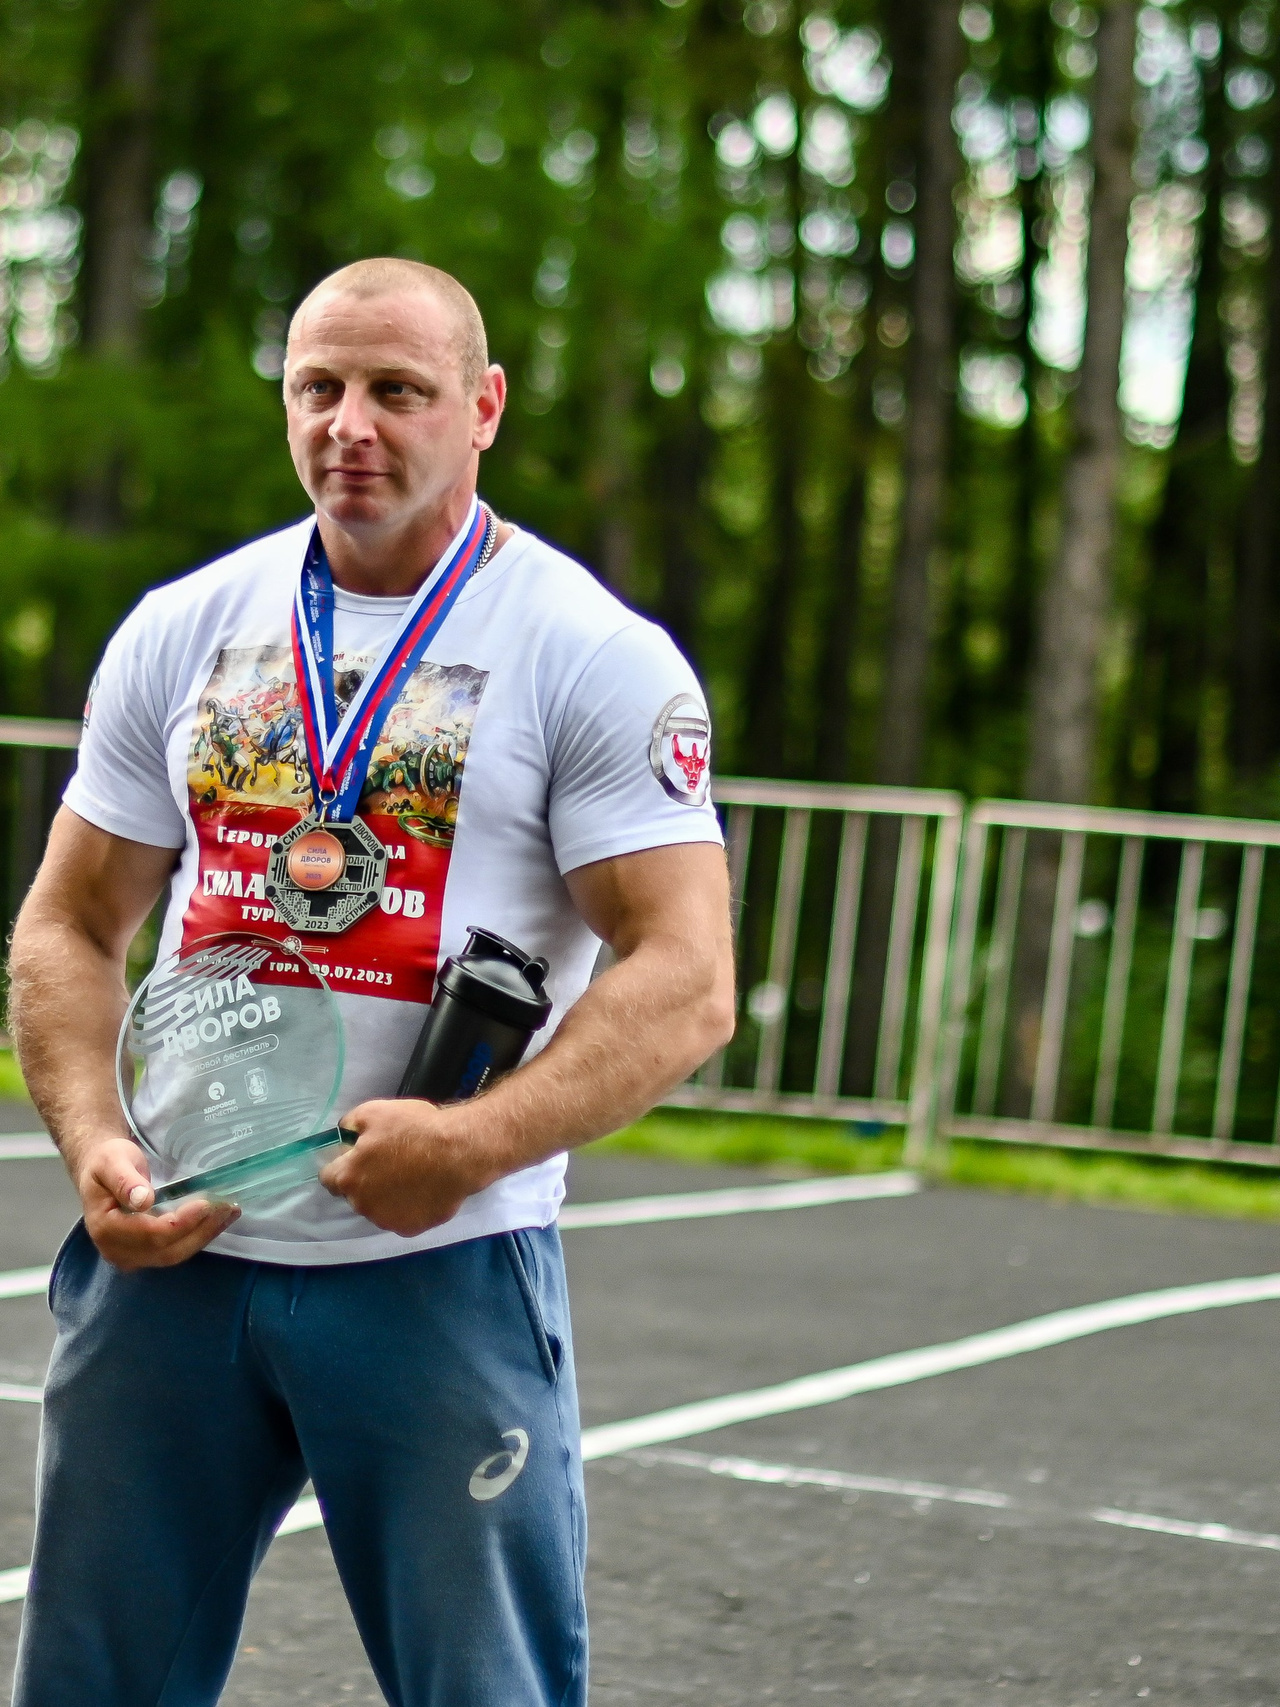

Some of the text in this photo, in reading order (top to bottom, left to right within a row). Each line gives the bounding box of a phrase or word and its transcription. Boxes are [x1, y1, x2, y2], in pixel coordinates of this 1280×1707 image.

[217, 825, 279, 849] ГЕРОЯ
[282, 820, 312, 846] СИЛА
[353, 822, 380, 852] ДВОРОВ
[300, 855, 332, 864] ДВОРОВ
[202, 870, 266, 900] СИЛА
[271, 894, 300, 927] СИЛОВОЙ
[304, 920, 329, 930] 2023
[335, 900, 371, 930] ЭКСТРИМ
[269, 961, 300, 974] ГОРА
[173, 973, 257, 1021] СИЛА
[162, 996, 282, 1062] ДВОРОВ
[203, 1098, 237, 1114] ЗДОРОВОЕ
[204, 1105, 239, 1121] ОТЕЧЕСТВО
[231, 1125, 253, 1139] 2023
